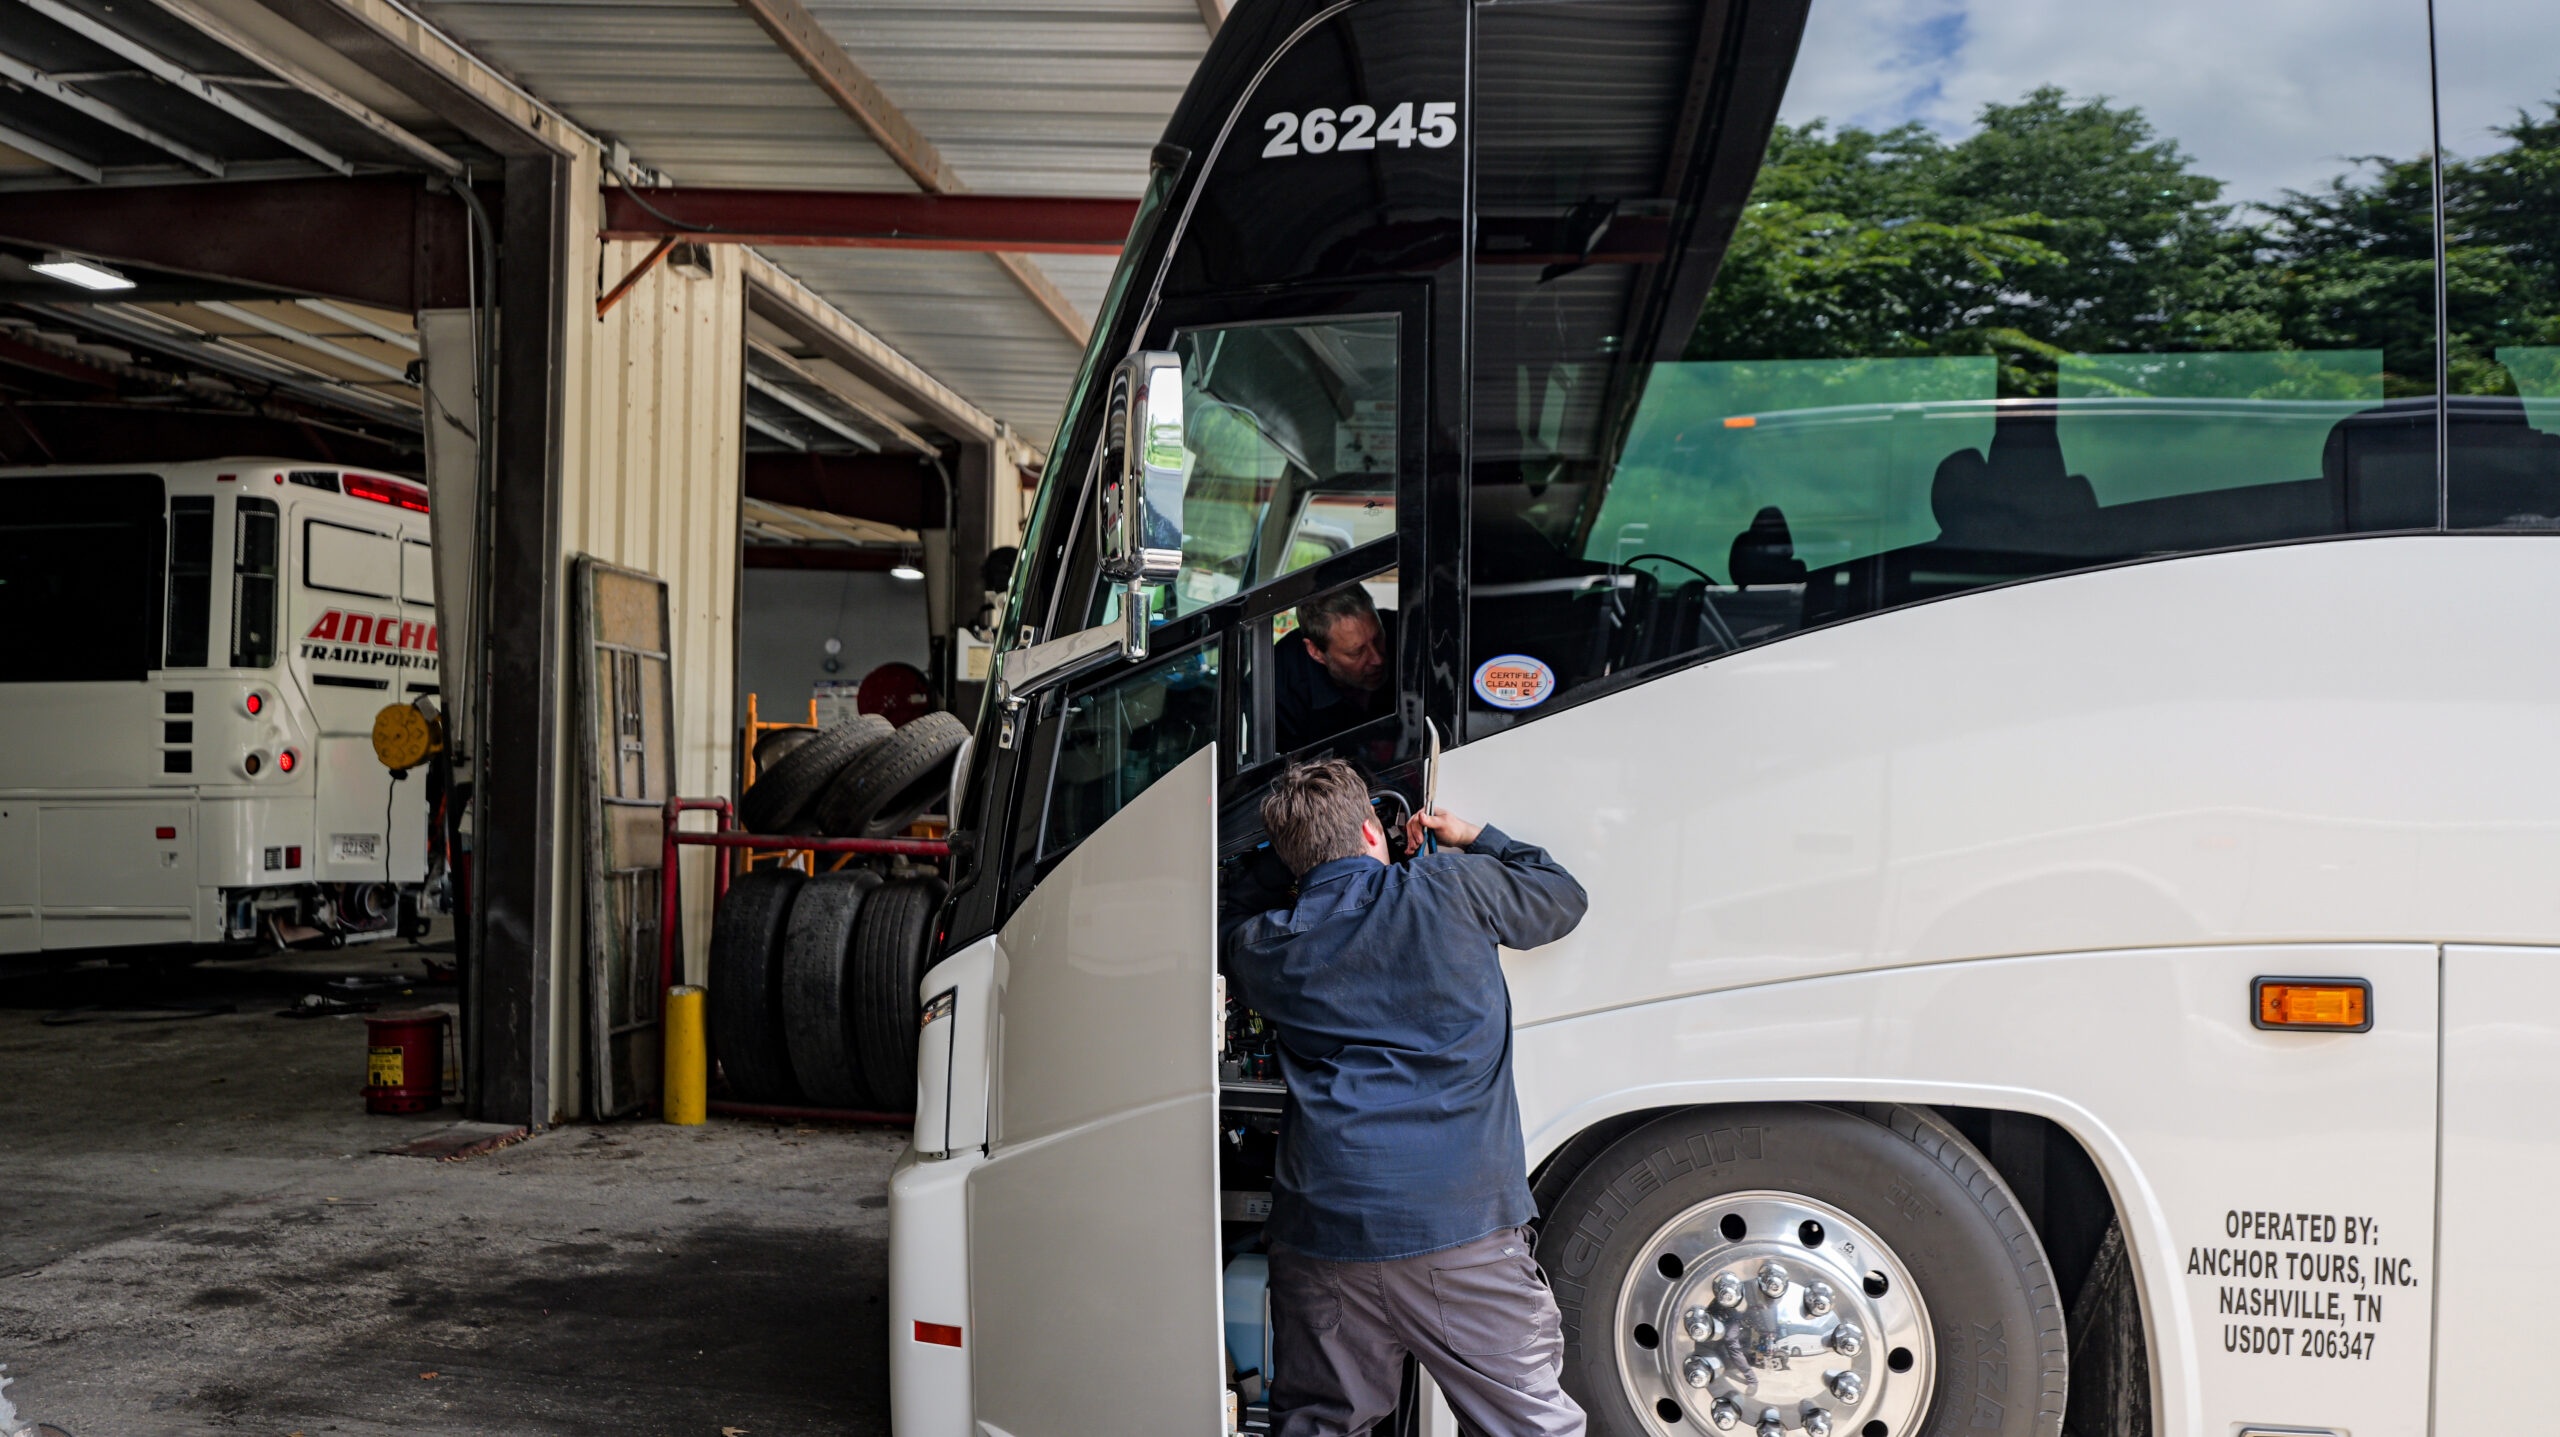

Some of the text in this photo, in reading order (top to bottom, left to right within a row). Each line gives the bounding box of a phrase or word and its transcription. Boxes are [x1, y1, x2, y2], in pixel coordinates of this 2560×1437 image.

[1262, 102, 1457, 158] 26245
[1486, 680, 1543, 688] CLEAN IDLE
[1490, 671, 1538, 680] CERTIFIED
[1553, 1126, 1764, 1362] MICHELIN
[2226, 1209, 2379, 1246] OPERATED BY:
[2187, 1247, 2418, 1290] ANCHOR TOURS, INC.
[2220, 1286, 2382, 1328] NASHVILLE, TN
[2224, 1324, 2376, 1361] USDOT 206347
